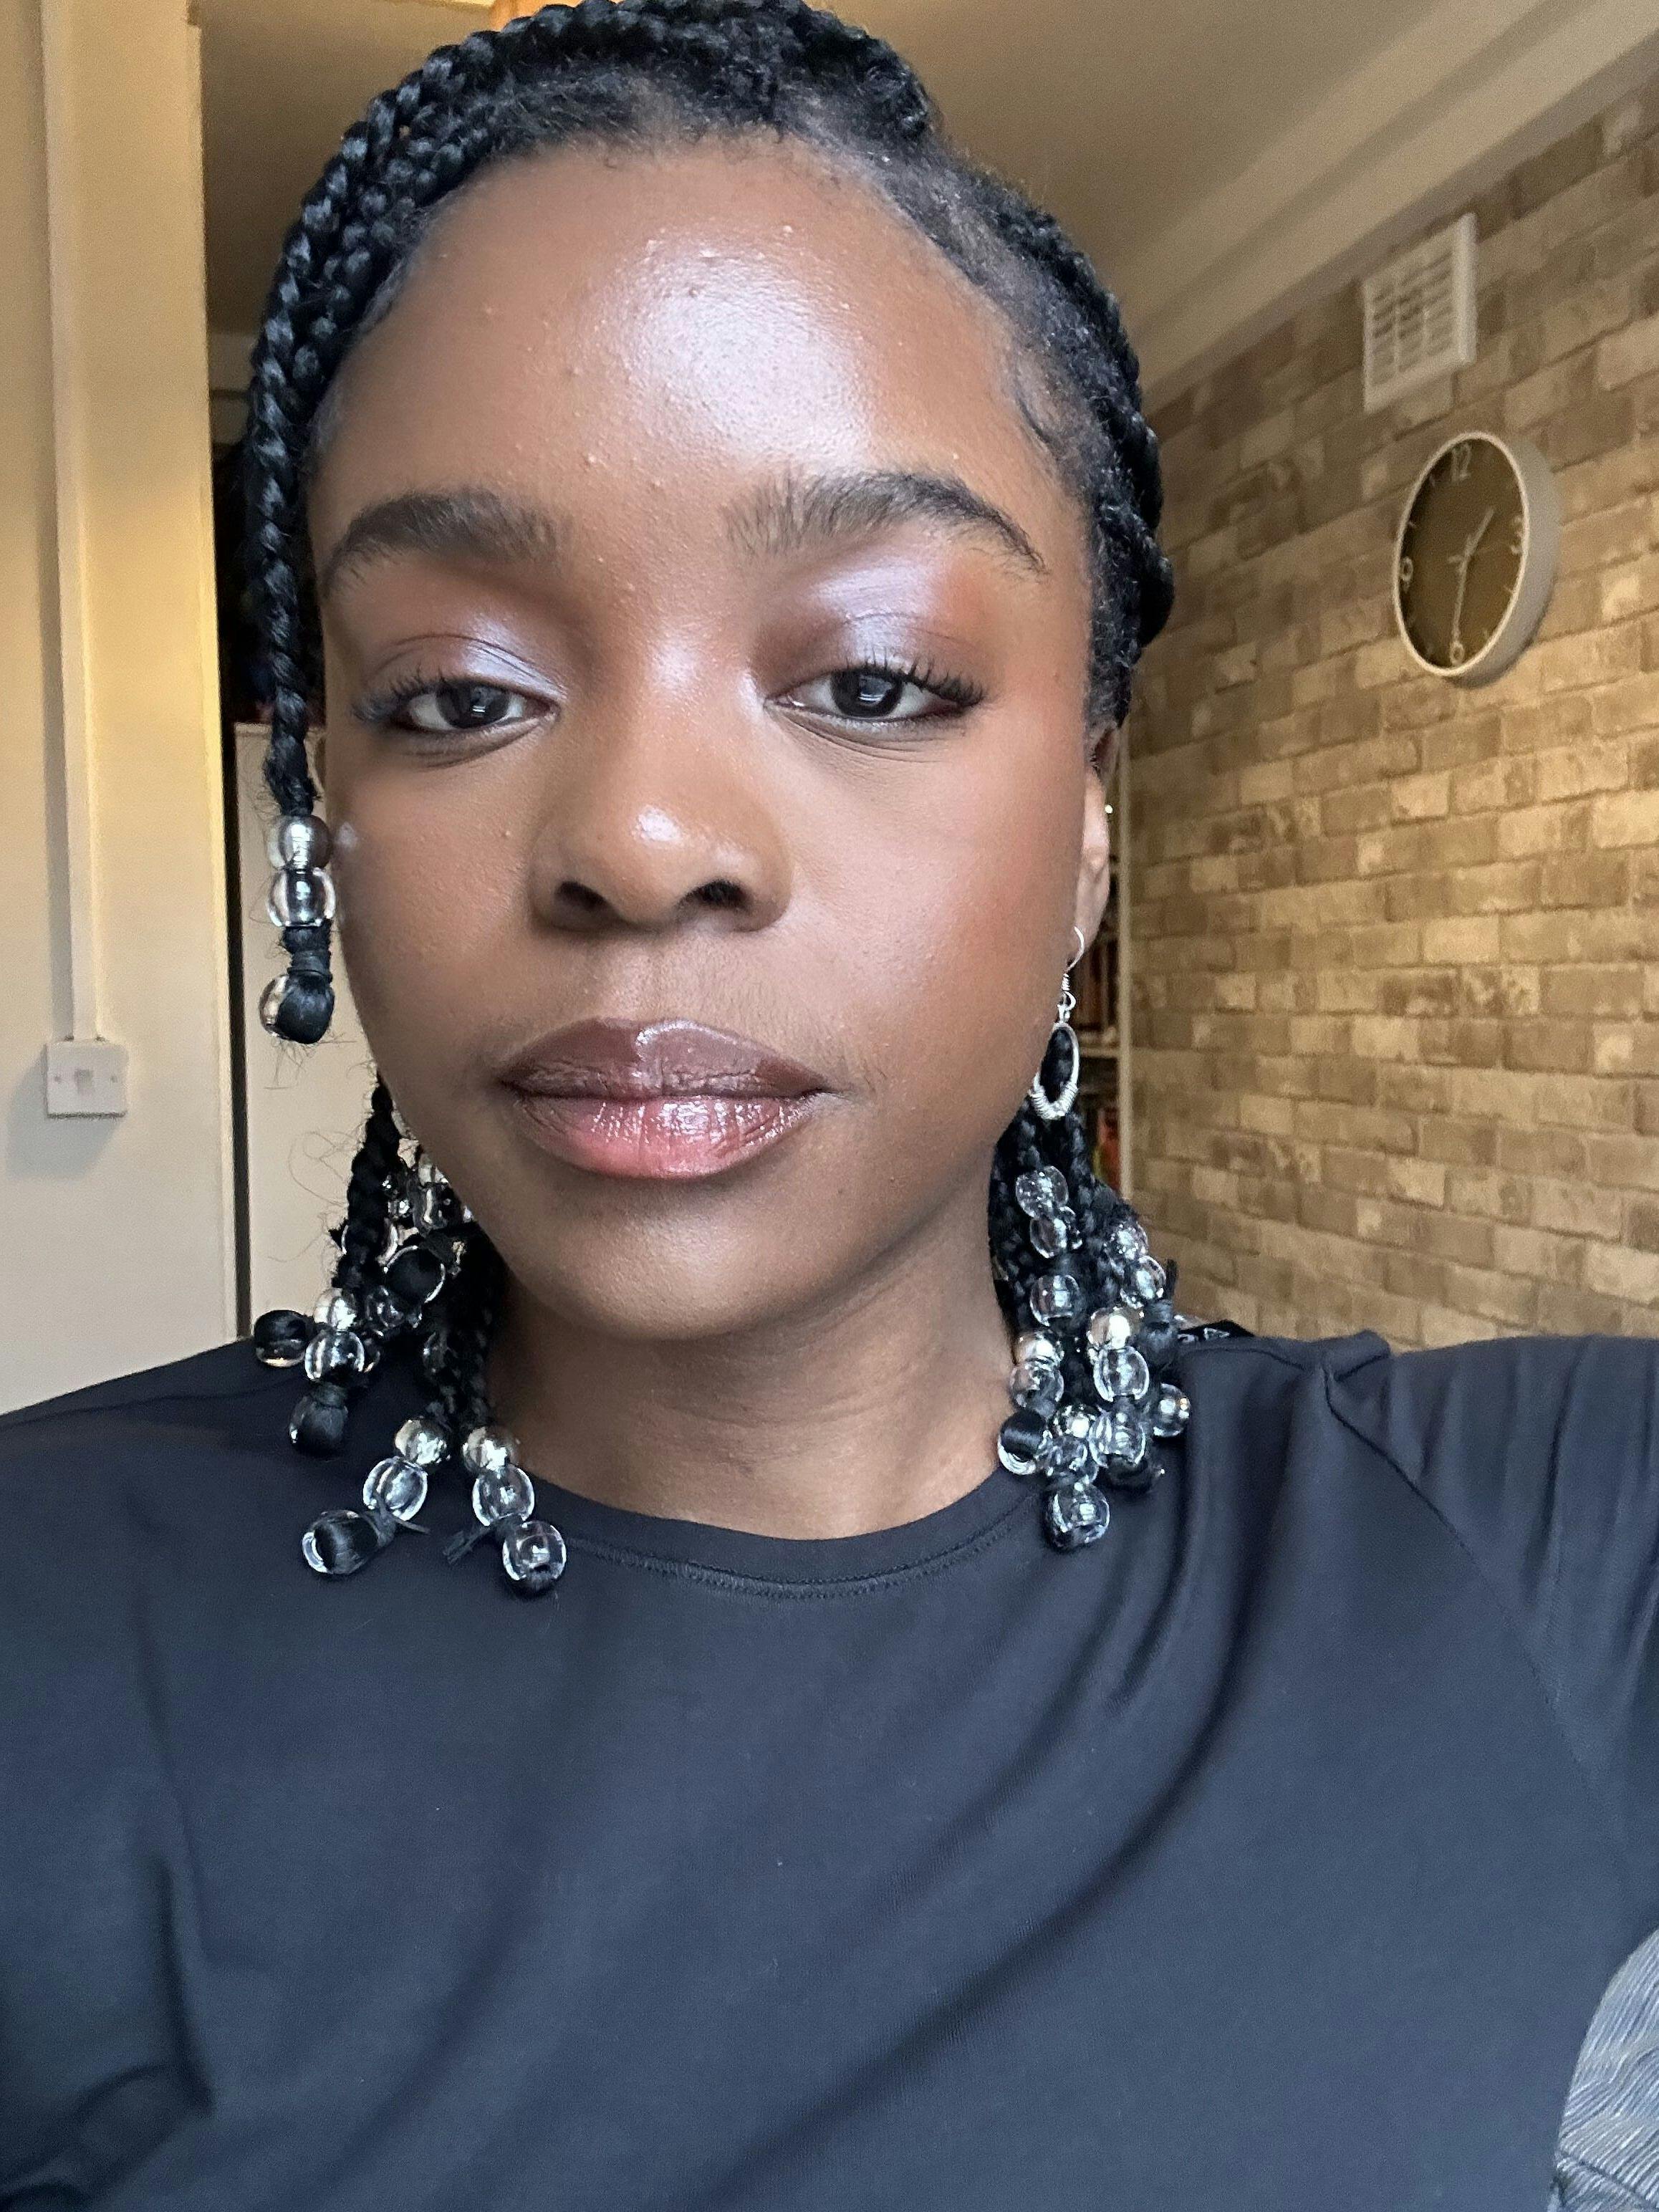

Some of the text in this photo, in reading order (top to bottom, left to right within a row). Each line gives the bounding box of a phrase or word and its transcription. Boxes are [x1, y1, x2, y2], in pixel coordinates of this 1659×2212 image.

[1451, 443, 1471, 481] 12
[1511, 515, 1524, 555] 3
[1400, 556, 1413, 592] 9
[1449, 630, 1465, 666] 6
